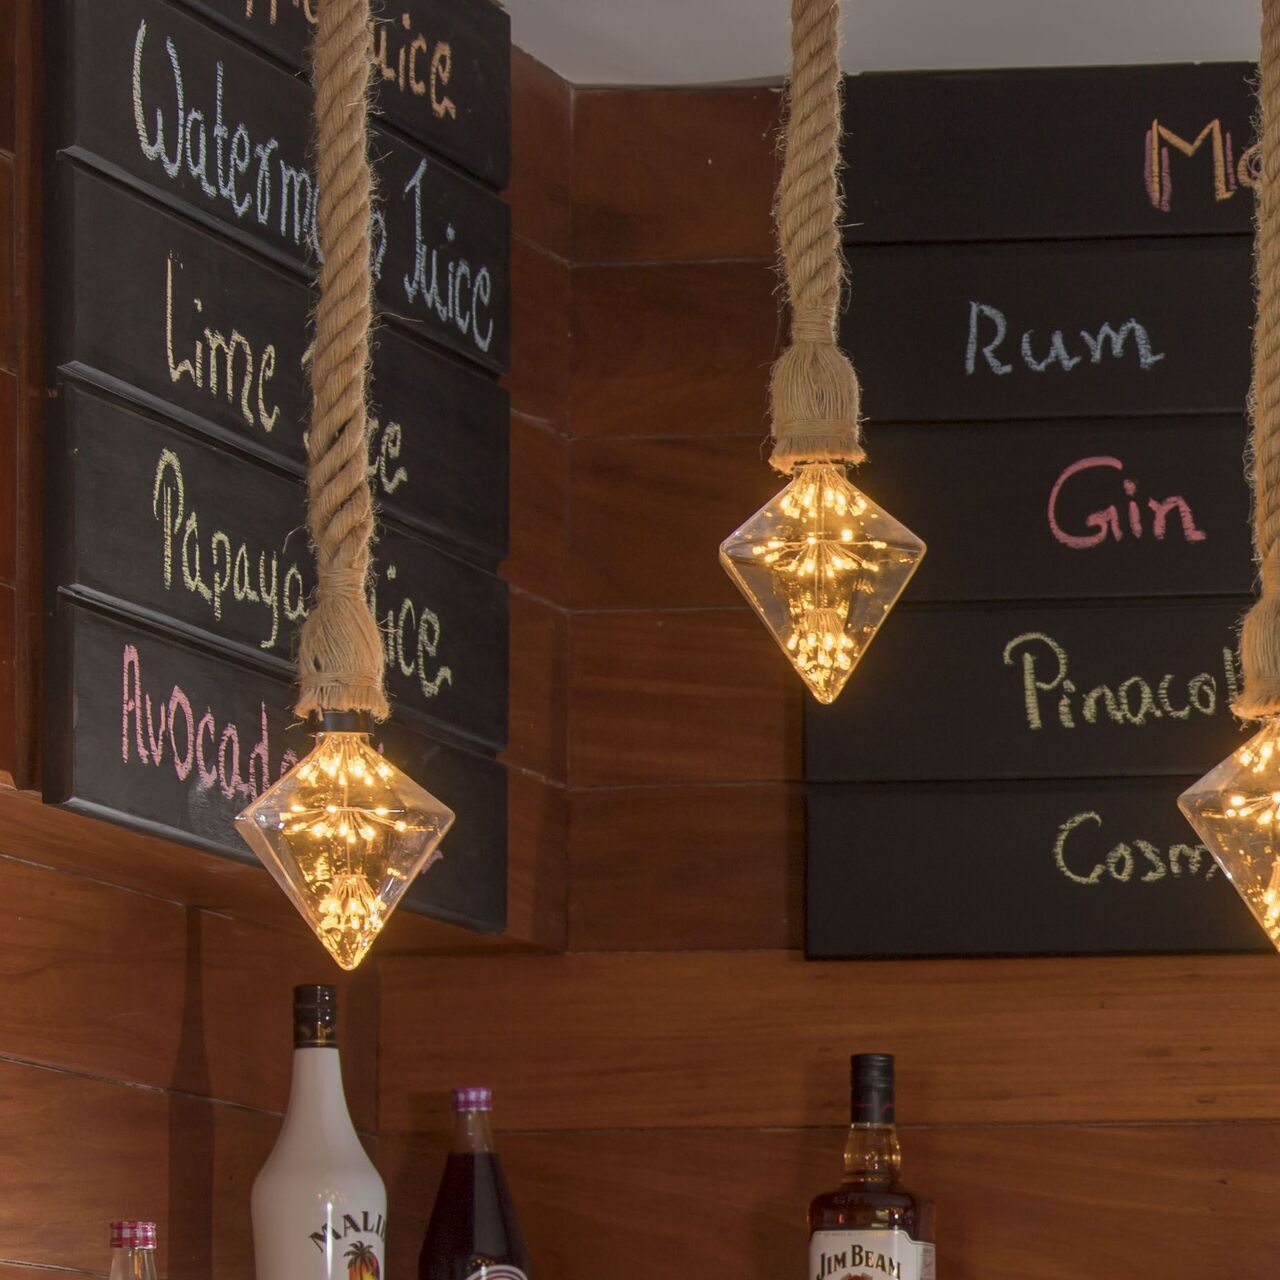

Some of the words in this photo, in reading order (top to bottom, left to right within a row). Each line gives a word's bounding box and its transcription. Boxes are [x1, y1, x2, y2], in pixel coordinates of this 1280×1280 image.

[367, 13, 456, 119] uice
[133, 19, 387, 280] Watermn
[404, 158, 493, 352] Juice
[167, 252, 280, 432] Lime
[965, 301, 1165, 375] Rum
[1047, 455, 1206, 549] Gin
[153, 447, 309, 648] Papaya
[371, 565, 452, 698] ice
[851, 1244, 901, 1280] BEAM
